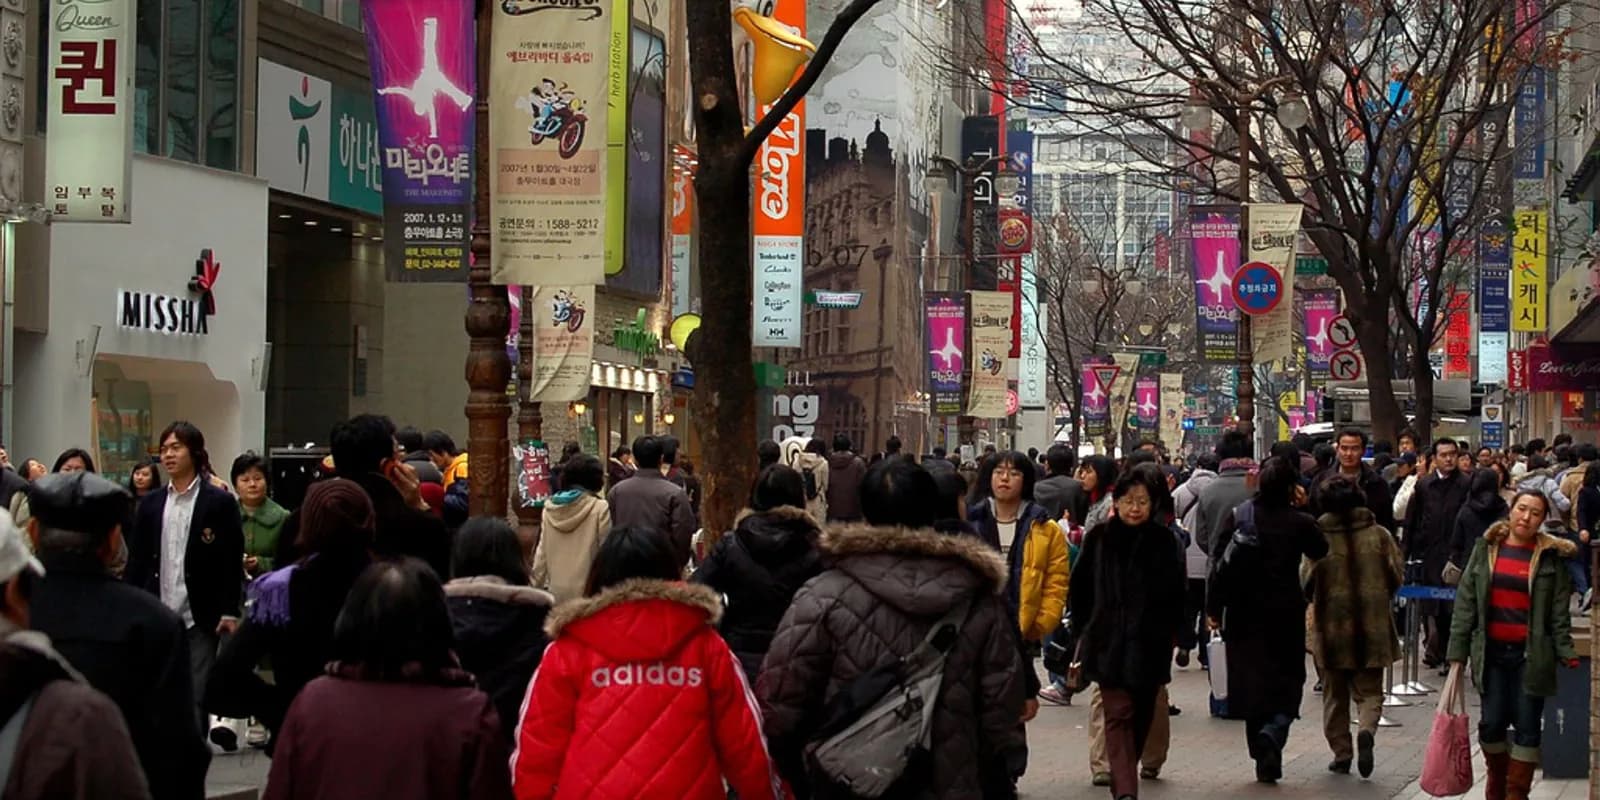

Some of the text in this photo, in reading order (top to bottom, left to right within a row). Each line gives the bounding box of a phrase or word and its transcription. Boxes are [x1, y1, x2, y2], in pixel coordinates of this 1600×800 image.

[55, 5, 119, 31] Queen
[613, 32, 621, 97] herb station
[1519, 213, 1539, 329] 러시 캐시
[118, 289, 209, 334] MISSHA
[591, 661, 703, 688] adidas
